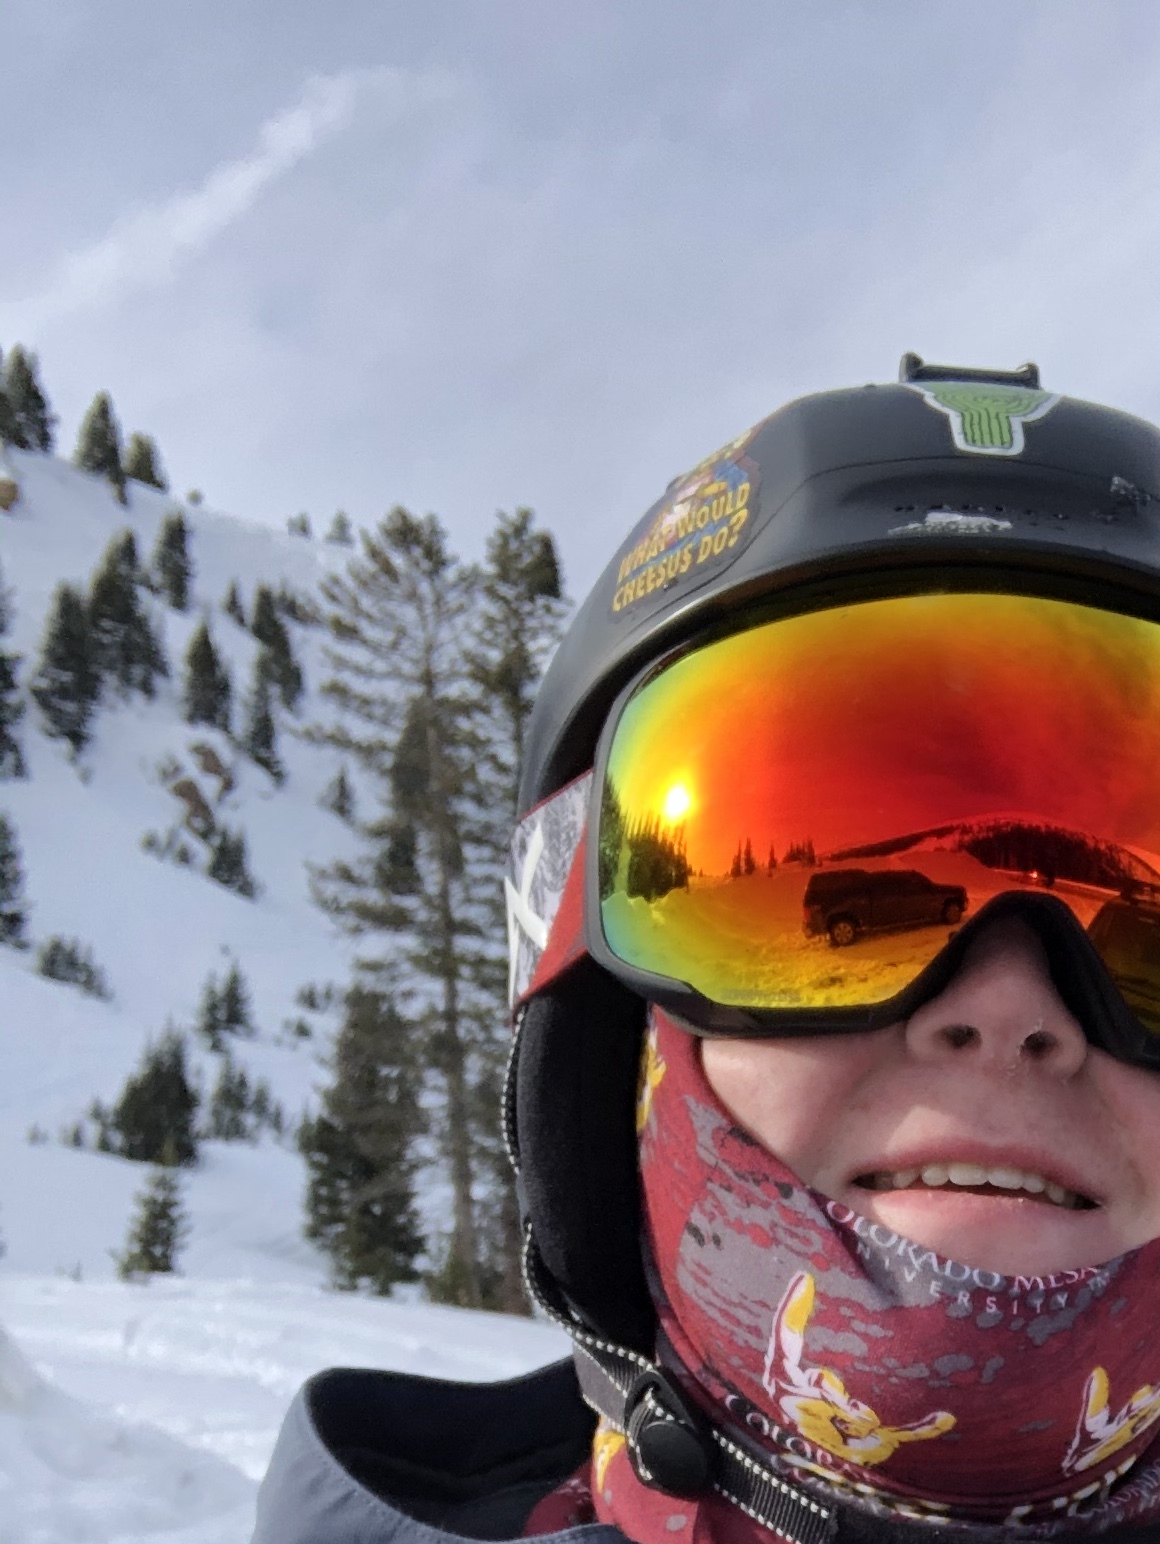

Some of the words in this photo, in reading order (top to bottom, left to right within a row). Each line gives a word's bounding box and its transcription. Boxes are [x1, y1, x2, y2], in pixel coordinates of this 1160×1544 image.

[676, 482, 750, 538] WOULD
[697, 508, 748, 564] DO?
[857, 1243, 1068, 1316] NIVERSITY
